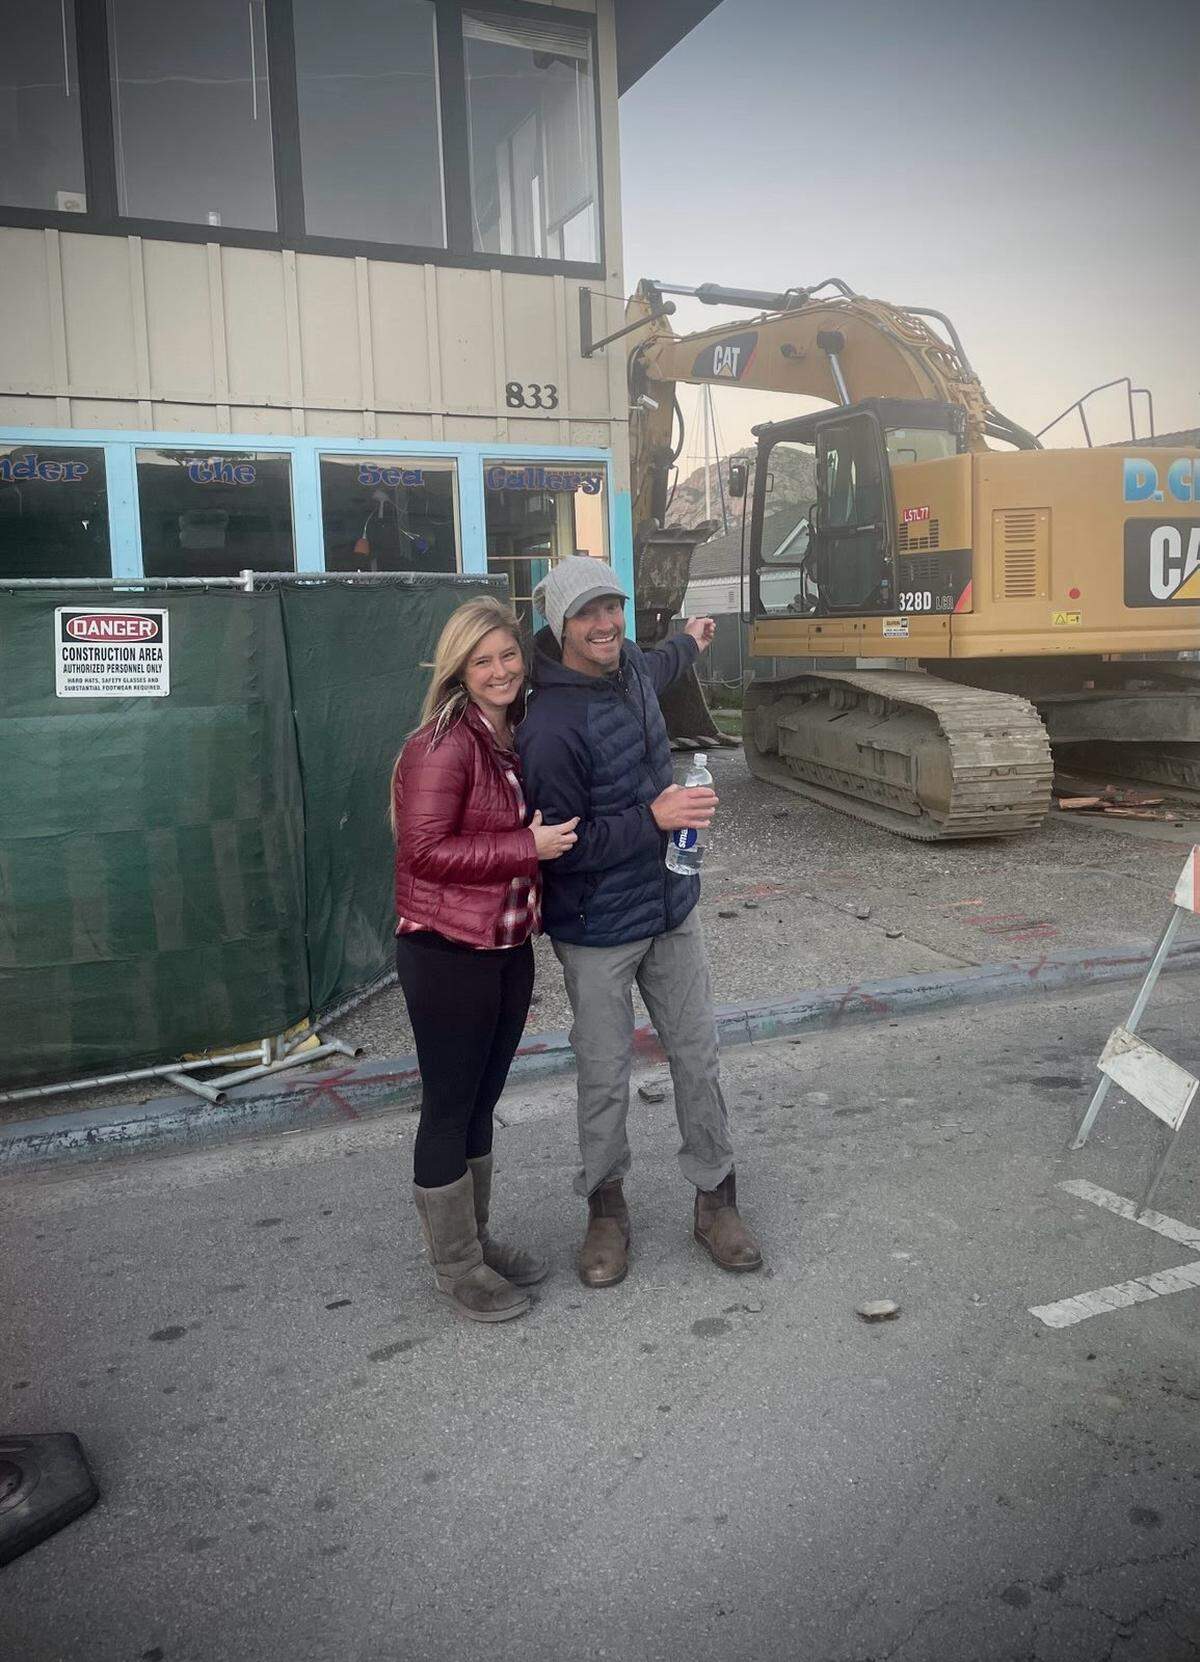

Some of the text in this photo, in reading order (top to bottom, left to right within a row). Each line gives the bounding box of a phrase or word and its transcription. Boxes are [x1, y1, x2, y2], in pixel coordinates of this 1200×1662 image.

[713, 345, 740, 377] CAT
[506, 382, 558, 409] 833
[357, 462, 425, 487] Sea
[486, 466, 602, 495] Gallery
[899, 591, 932, 611] 328D
[73, 620, 153, 636] DANGER
[62, 646, 163, 661] CONSTRUCTION AREA
[62, 663, 163, 674] AUTHORIZED PERSONNEL ONLY
